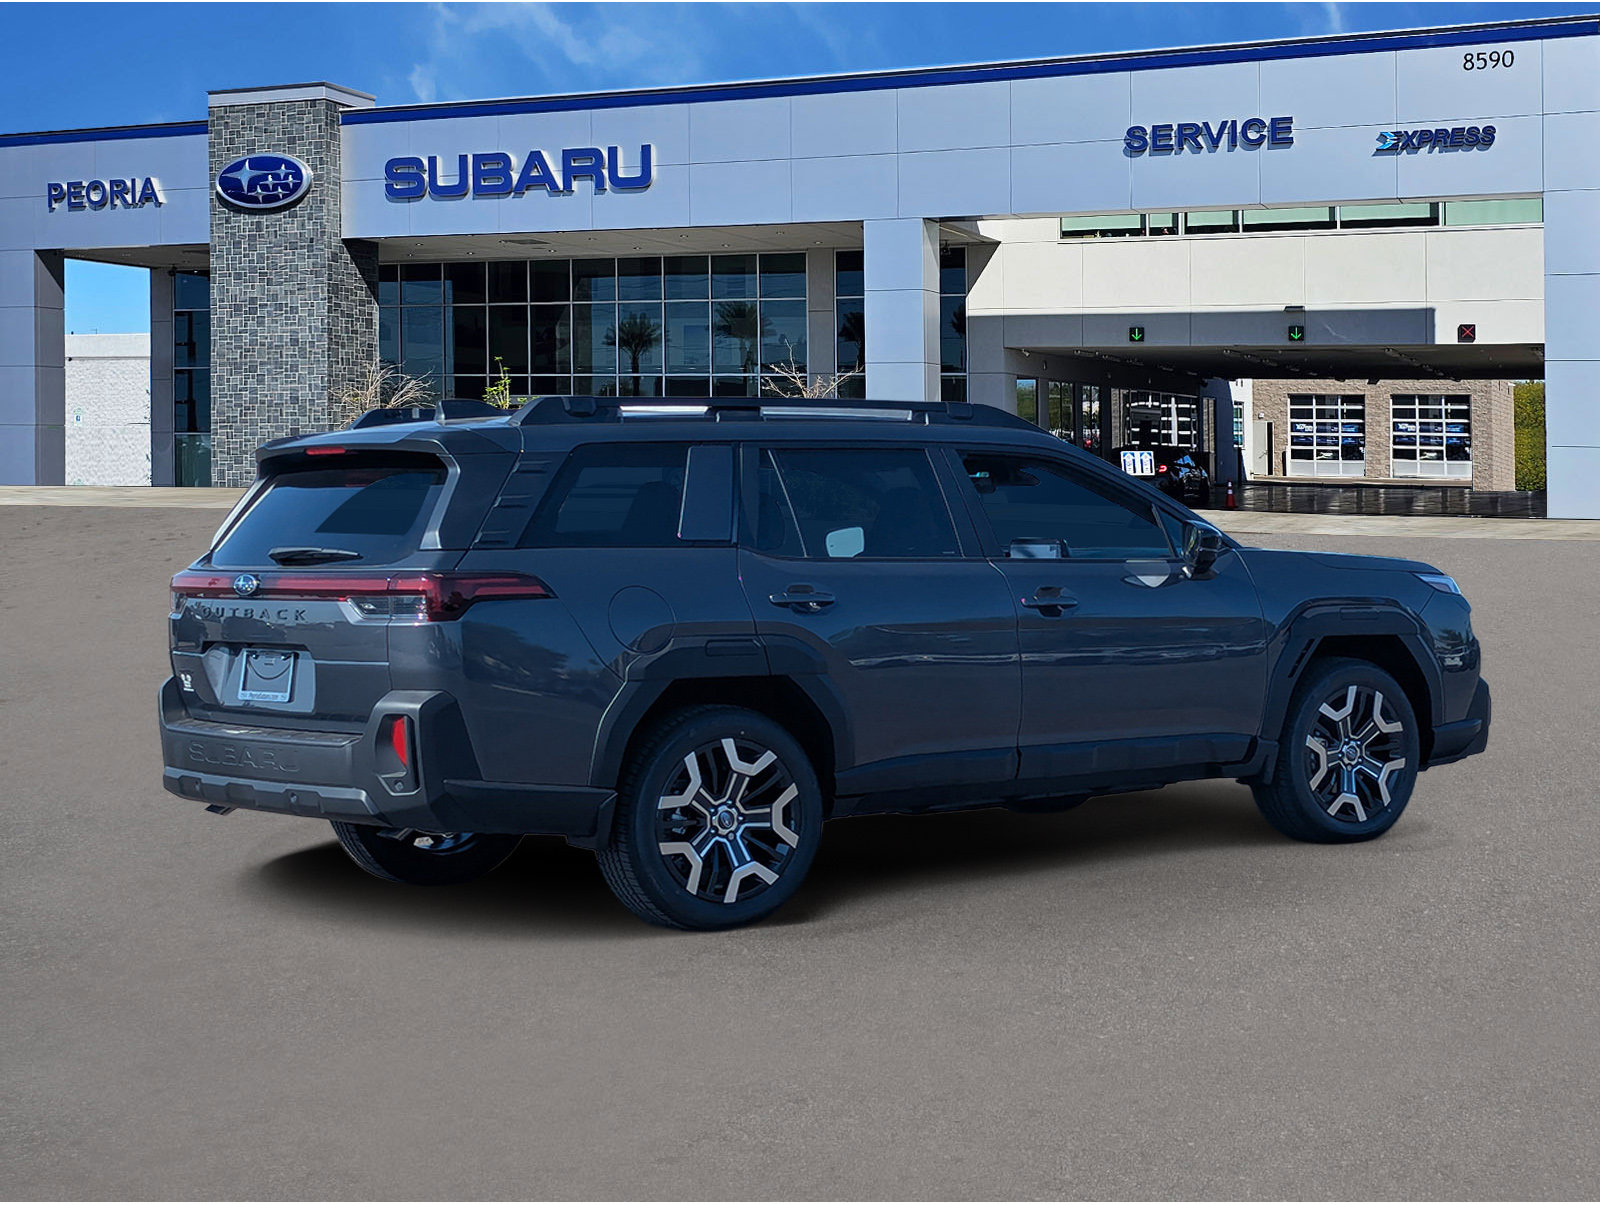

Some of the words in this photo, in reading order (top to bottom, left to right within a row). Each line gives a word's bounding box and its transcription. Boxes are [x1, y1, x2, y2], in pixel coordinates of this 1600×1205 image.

[1463, 50, 1514, 70] 8590
[1126, 117, 1294, 153] SERVICE
[1375, 125, 1497, 150] EXPRESS
[384, 144, 652, 200] SUBARU
[47, 177, 163, 210] PEORIA
[202, 606, 306, 621] OUTBACK
[188, 741, 300, 772] SUBARU
